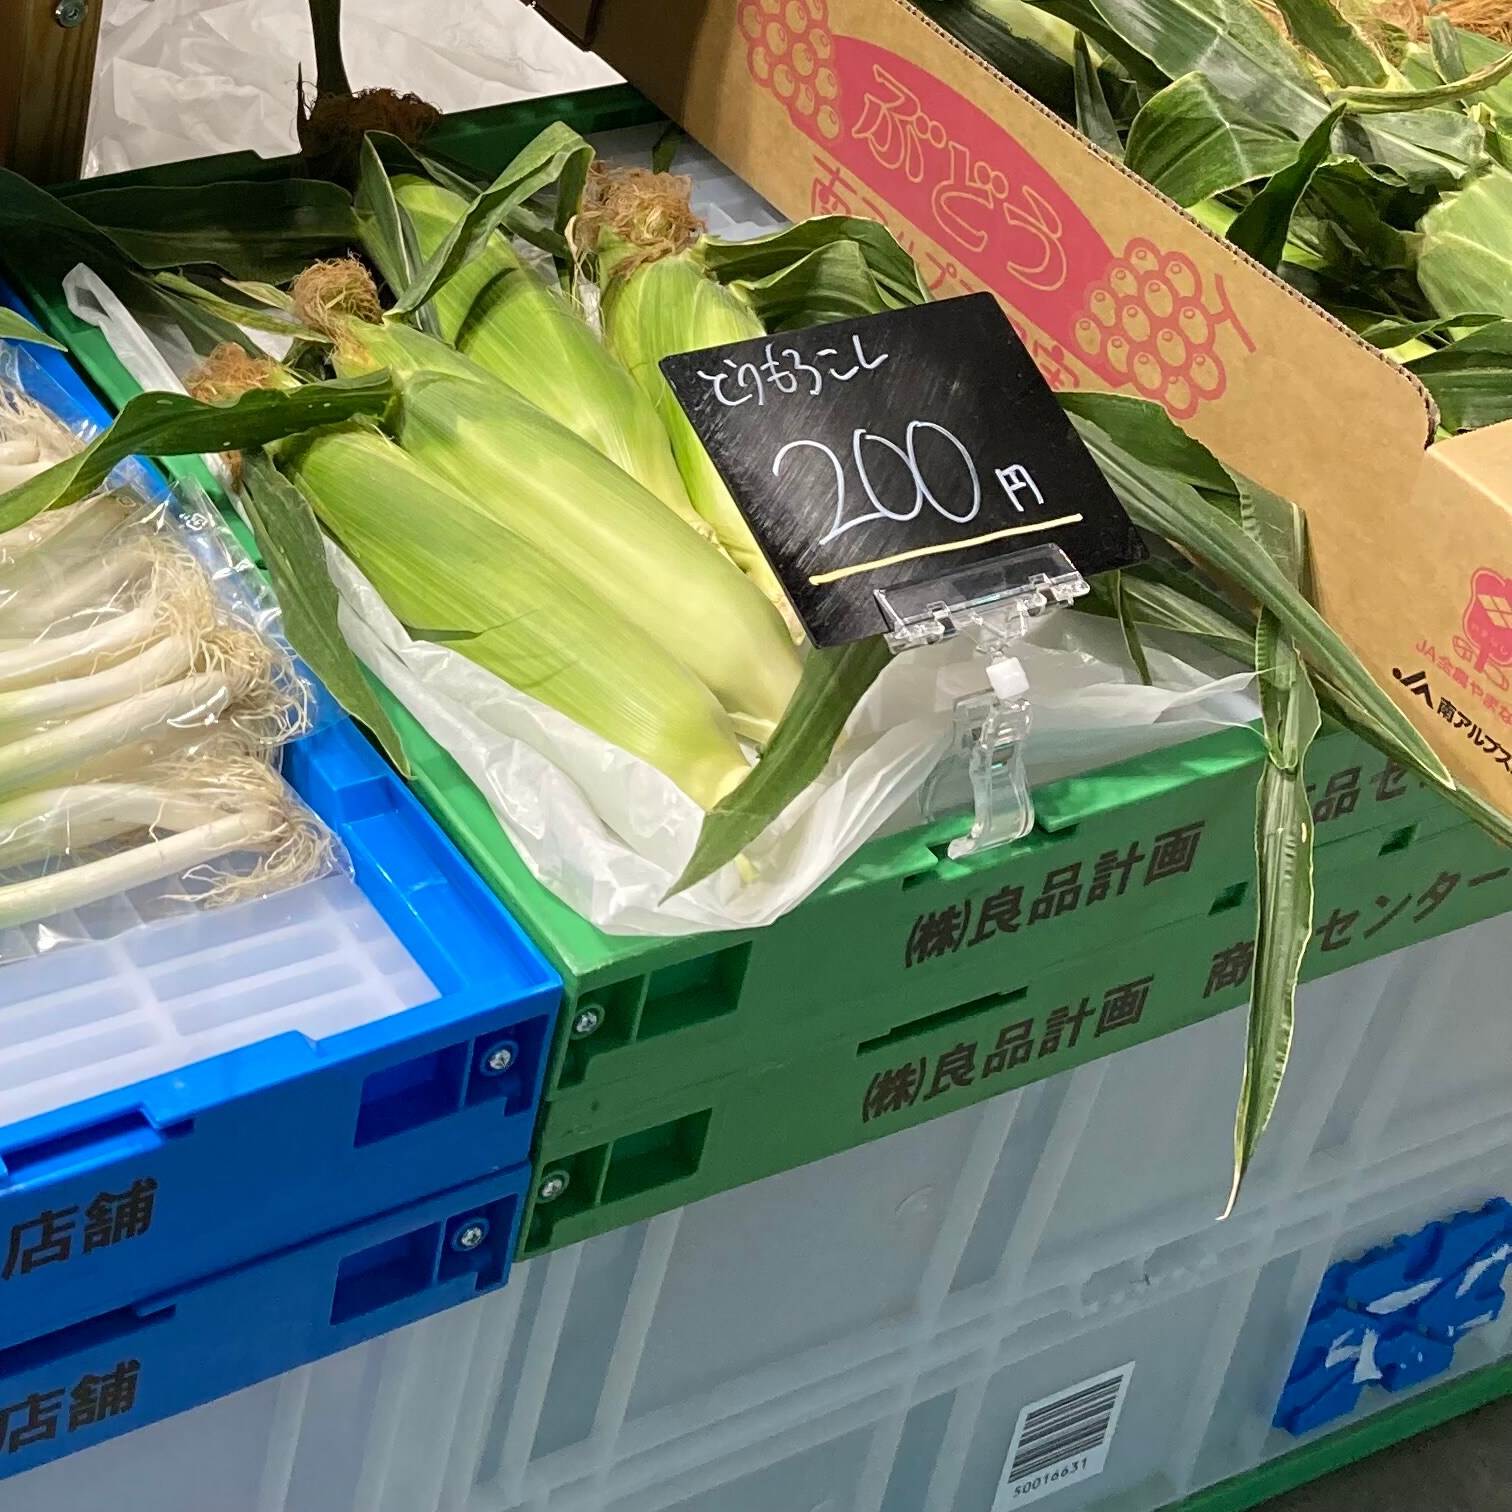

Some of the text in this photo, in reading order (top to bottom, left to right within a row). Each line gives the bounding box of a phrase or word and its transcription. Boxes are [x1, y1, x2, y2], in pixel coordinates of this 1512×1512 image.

[850, 63, 1069, 292] ぶどう
[771, 419, 1045, 546] 200円
[904, 819, 1205, 968] (株)良品計画
[861, 974, 1155, 1124] (株)良品計画
[1, 1176, 158, 1281] 店舗
[1010, 1456, 1089, 1499] 50016631
